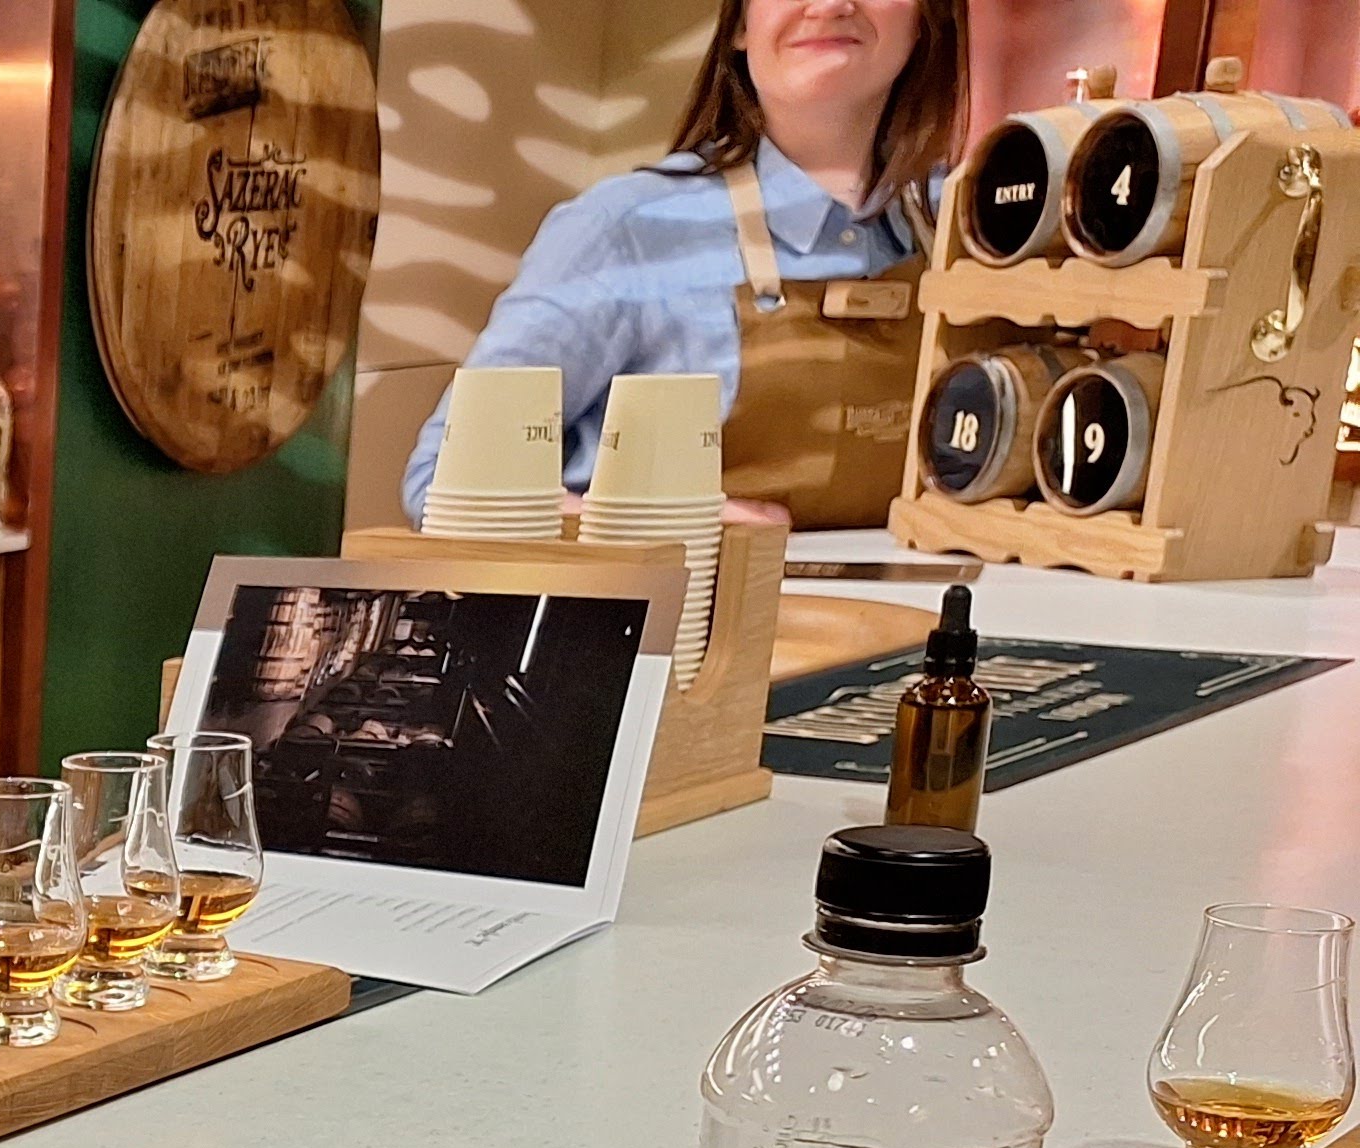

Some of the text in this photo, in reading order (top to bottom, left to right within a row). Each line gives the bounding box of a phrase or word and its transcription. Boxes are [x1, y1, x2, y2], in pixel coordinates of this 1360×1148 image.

[195, 148, 306, 240] SAZERAC
[994, 183, 1036, 205] ENTRY
[1110, 164, 1132, 206] 4
[226, 216, 281, 292] RYE
[949, 409, 979, 452] 18
[1084, 422, 1106, 464] 9
